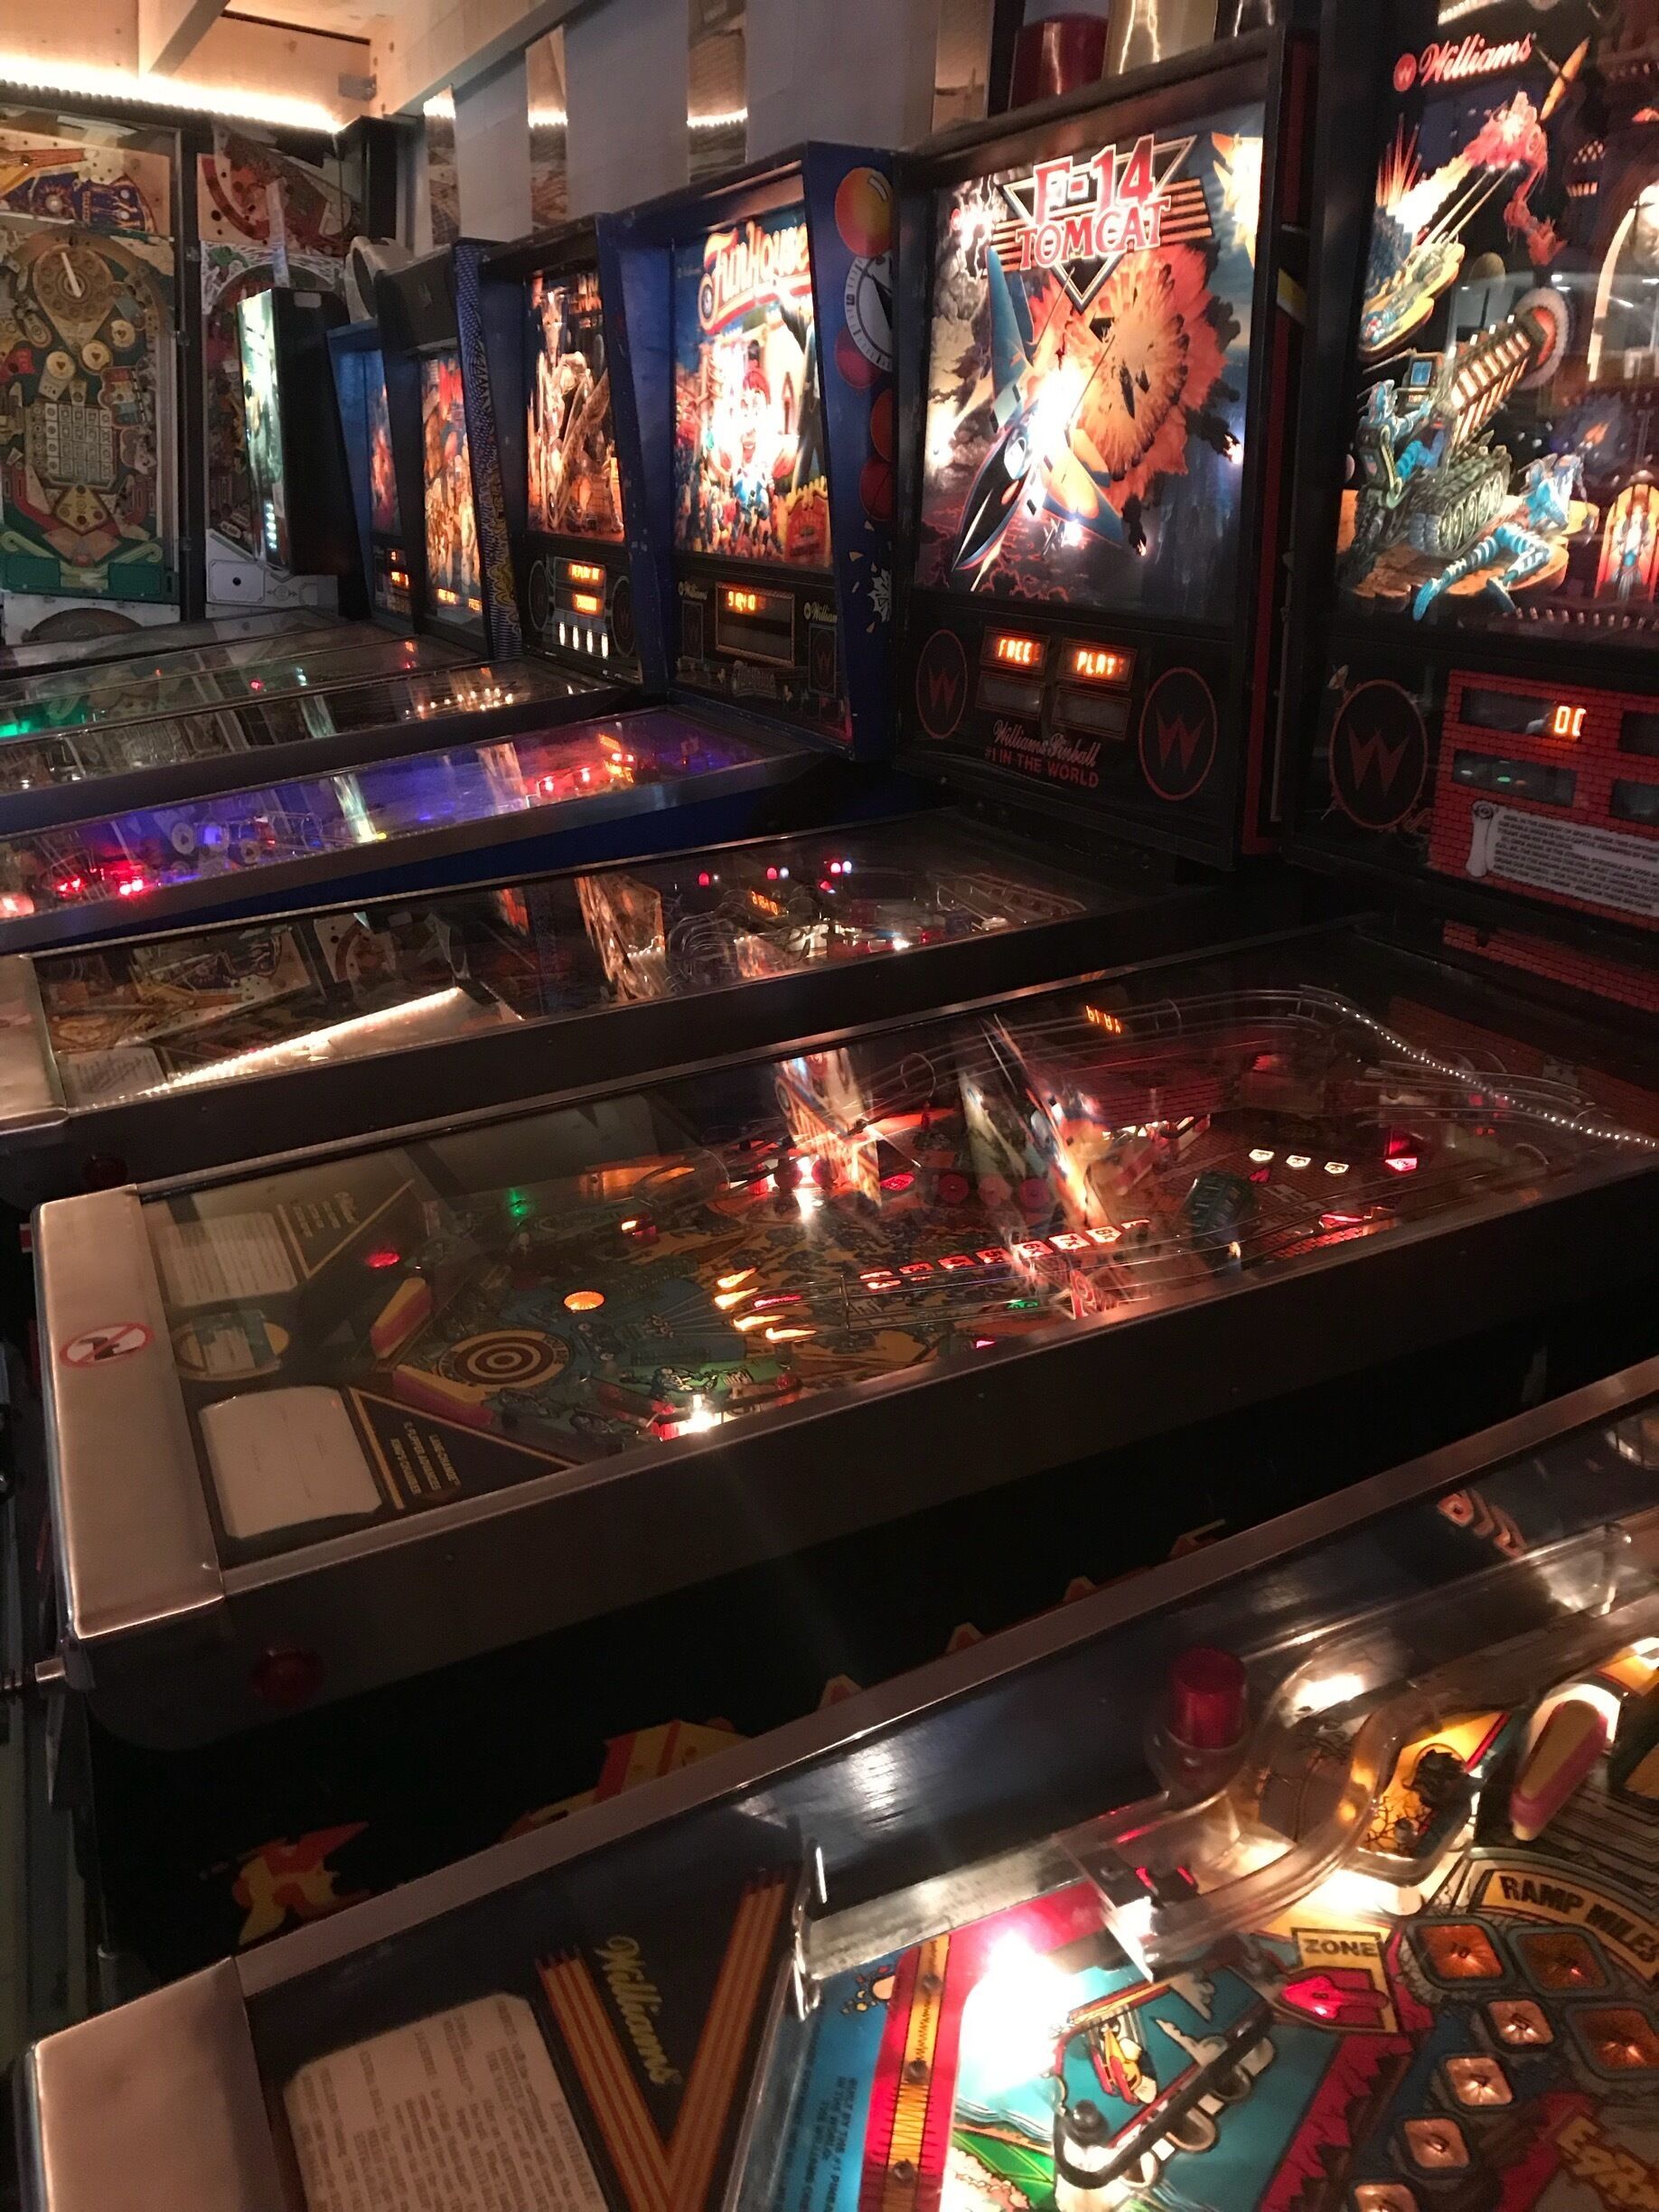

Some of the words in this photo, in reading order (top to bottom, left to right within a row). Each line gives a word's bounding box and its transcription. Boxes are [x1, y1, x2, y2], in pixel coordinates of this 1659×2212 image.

[1419, 33, 1534, 87] Williams
[1034, 134, 1157, 226] F-14
[1016, 196, 1172, 270] TOMCAT
[811, 601, 838, 624] William
[998, 638, 1034, 664] FREE
[1076, 651, 1118, 676] PLAY
[994, 720, 1048, 756] Williams
[1048, 733, 1101, 768] Pinball
[998, 747, 1013, 765] IN
[1017, 754, 1043, 773] THE
[1046, 761, 1101, 789] WORLD
[408, 1429, 426, 1456] FLIPPER
[417, 1455, 442, 1491] ADVANCES
[1499, 1876, 1585, 1917] RAMP
[1584, 1903, 1659, 1964] MILES
[1301, 1938, 1381, 1959] ZONE
[594, 1937, 681, 2085] Williams
